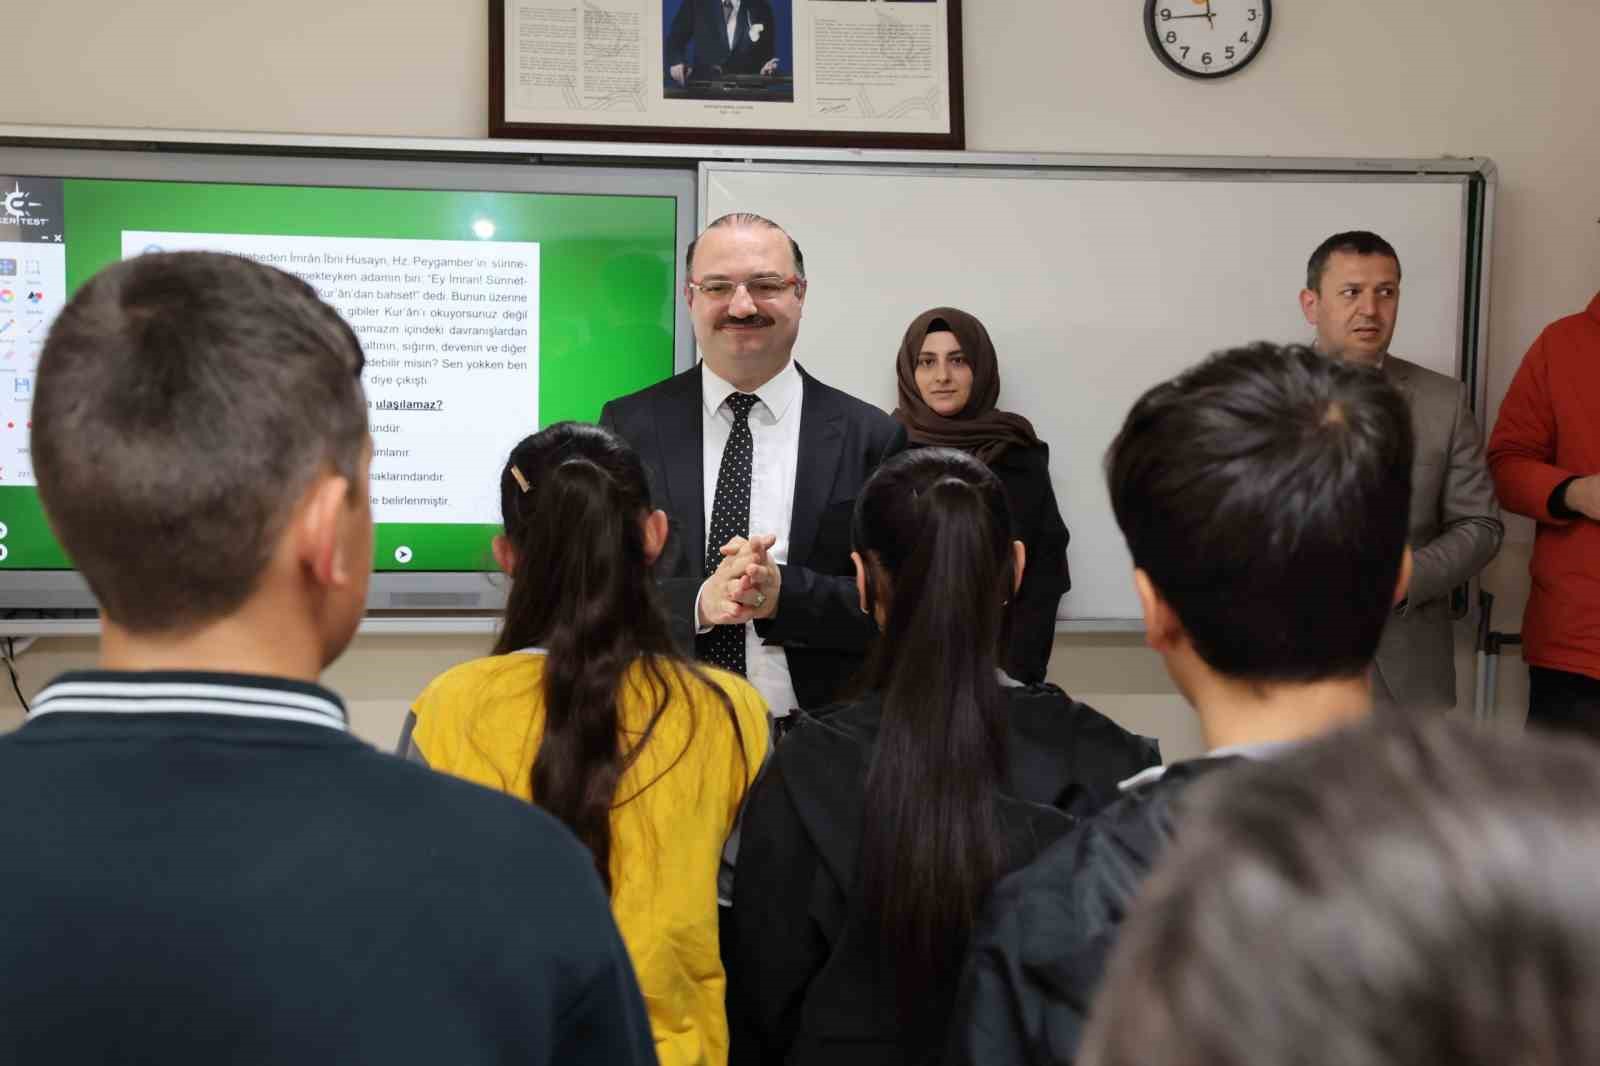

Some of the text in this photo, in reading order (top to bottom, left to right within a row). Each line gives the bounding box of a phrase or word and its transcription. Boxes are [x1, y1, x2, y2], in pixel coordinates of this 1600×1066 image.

[1160, 8, 1172, 21] 9
[1247, 8, 1257, 21] 3
[1166, 31, 1177, 44] 8
[1239, 31, 1249, 44] 4
[1179, 46, 1190, 60] 7
[1201, 52, 1212, 65] 6
[1224, 46, 1235, 60] 5
[451, 291, 486, 303] Bunun
[489, 292, 528, 304] üzerine
[347, 305, 379, 318] gibiler
[430, 308, 498, 321] okuyorsunuz
[502, 309, 528, 322] değil
[404, 324, 444, 337] içindeki
[449, 325, 527, 338] davranışlardan
[441, 342, 483, 354] devenin
[486, 345, 498, 354] ve
[501, 343, 527, 356] diğer
[404, 358, 439, 369] misin?
[441, 359, 463, 370] Sen
[467, 359, 504, 373] yokken
[507, 360, 527, 371] ben
[371, 375, 393, 387] diye
[375, 399, 444, 412] ulaşılamaz?
